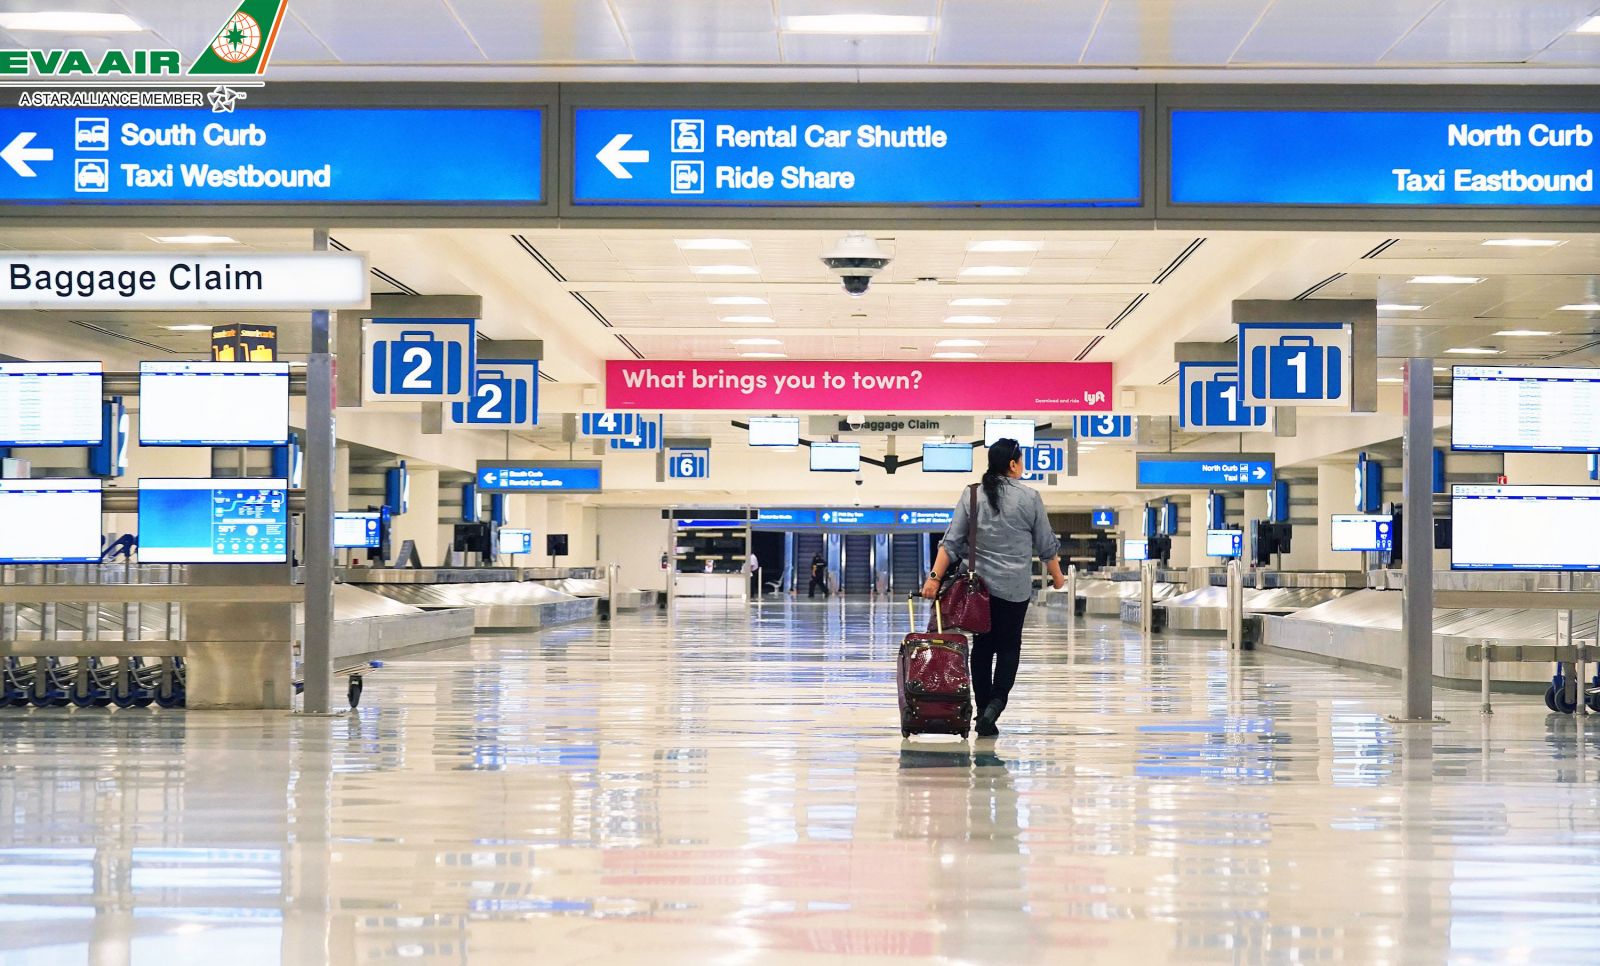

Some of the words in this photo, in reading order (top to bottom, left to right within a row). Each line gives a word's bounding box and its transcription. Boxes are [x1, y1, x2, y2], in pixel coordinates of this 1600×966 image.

[121, 123, 196, 146] South
[203, 123, 267, 146] Curb
[716, 124, 797, 148] Rental
[805, 124, 851, 148] Car
[857, 124, 947, 148] Shuttle
[1448, 124, 1521, 147] North
[1528, 124, 1593, 147] Curb
[121, 163, 174, 188] Taxi
[180, 163, 331, 188] Westbound
[716, 165, 774, 189] Ride
[781, 165, 856, 189] Share
[1391, 168, 1446, 192] Taxi
[1454, 168, 1593, 192] Eastbound
[10, 263, 156, 297] Baggage
[169, 263, 263, 291] Claim
[402, 347, 432, 389] 2
[1287, 351, 1306, 394] 1
[622, 368, 686, 389] What
[692, 368, 768, 395] brings
[773, 374, 816, 395] you
[822, 371, 846, 390] to
[852, 369, 923, 390] town?
[476, 383, 502, 419] 2
[1220, 385, 1237, 422] 1
[597, 413, 617, 432] 4
[860, 421, 905, 431] aggage
[908, 420, 940, 429] Claim
[1097, 415, 1115, 434] 3
[680, 458, 694, 476] 6
[1037, 450, 1051, 470] 5
[1202, 464, 1221, 472] North
[1222, 464, 1239, 472] Curb
[1223, 474, 1238, 482] Taxi
